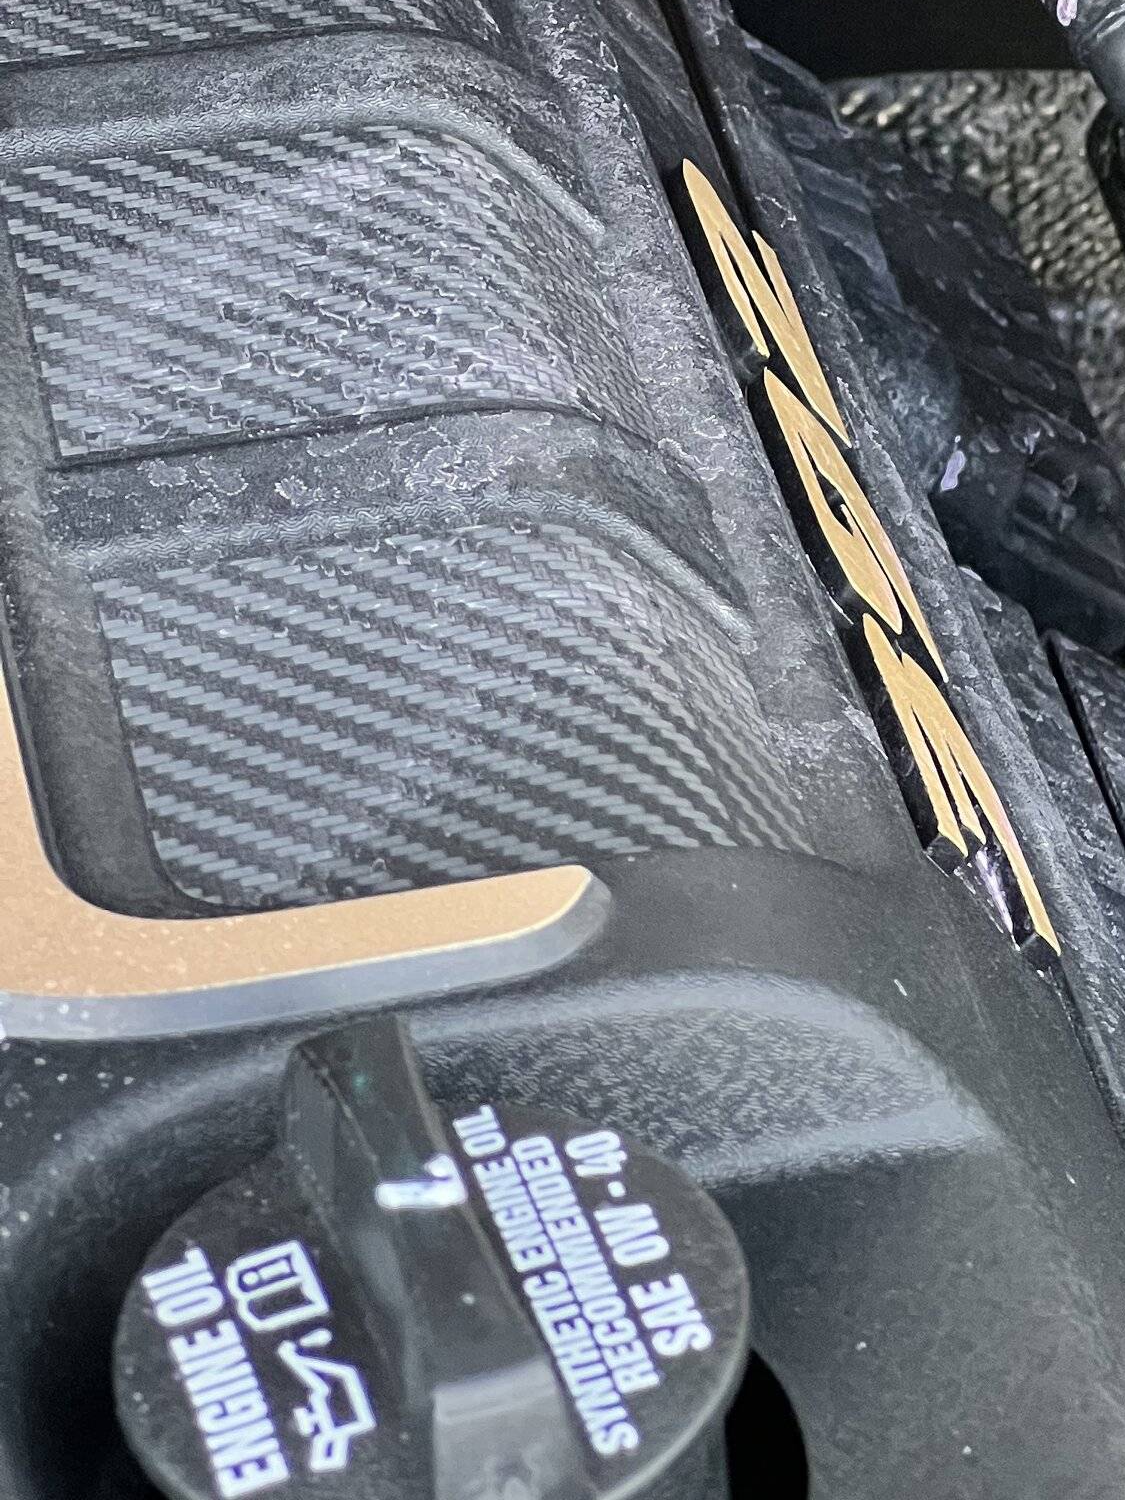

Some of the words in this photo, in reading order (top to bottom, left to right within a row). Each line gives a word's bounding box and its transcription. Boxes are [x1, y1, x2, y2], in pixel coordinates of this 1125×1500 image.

[453, 1104, 506, 1158] OIL
[471, 1155, 557, 1273] ENGINE
[511, 1135, 661, 1394] RECOMMENDED
[141, 1248, 225, 1328] OIL
[628, 1273, 713, 1358] SAE
[168, 1319, 290, 1499] ENGINE
[522, 1270, 640, 1457] SYNTHETIC
